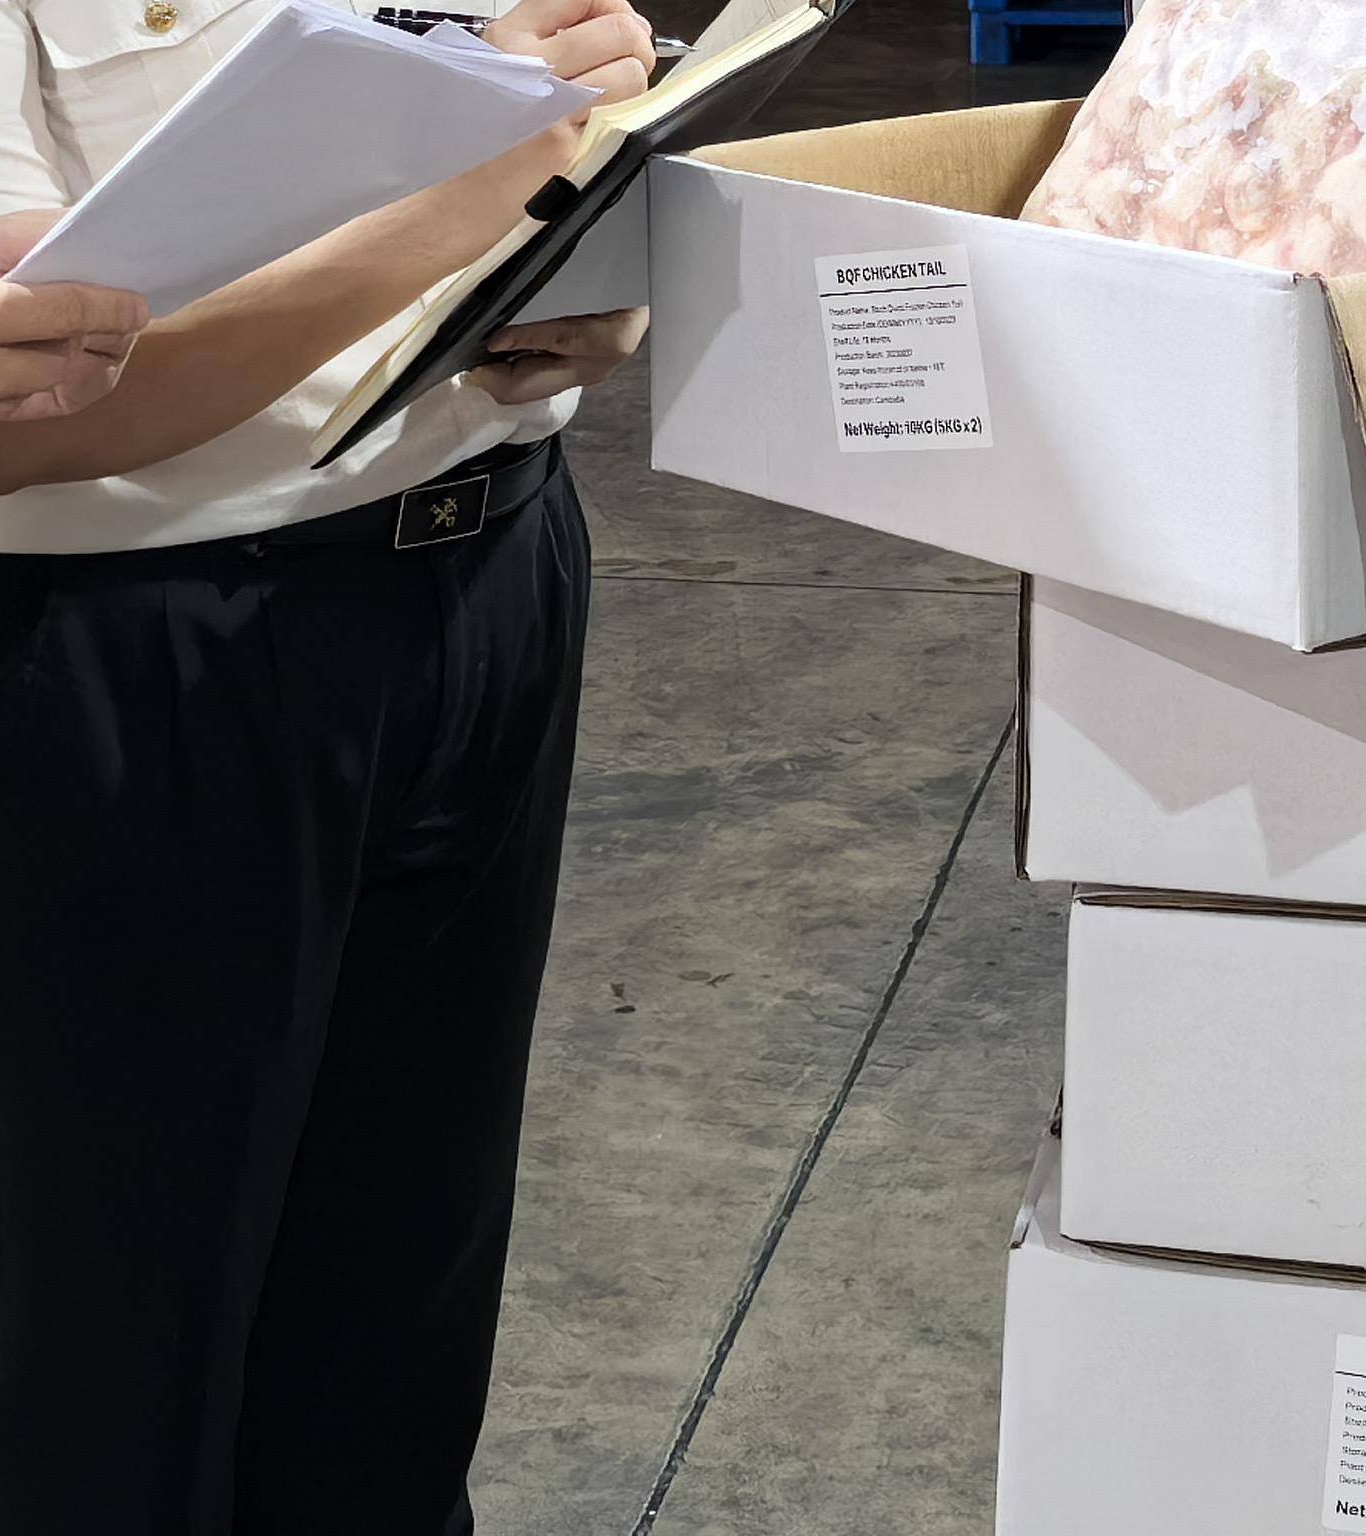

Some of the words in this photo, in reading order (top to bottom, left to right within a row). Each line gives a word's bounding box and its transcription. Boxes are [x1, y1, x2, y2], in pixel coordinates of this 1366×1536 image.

[836, 267, 860, 285] BQF
[862, 263, 917, 281] CHICKEN
[917, 261, 946, 277] TAIL
[844, 422, 862, 437] Net
[863, 419, 903, 439] Weight:
[905, 419, 932, 435] 10KG
[1335, 1499, 1366, 1519] Net
